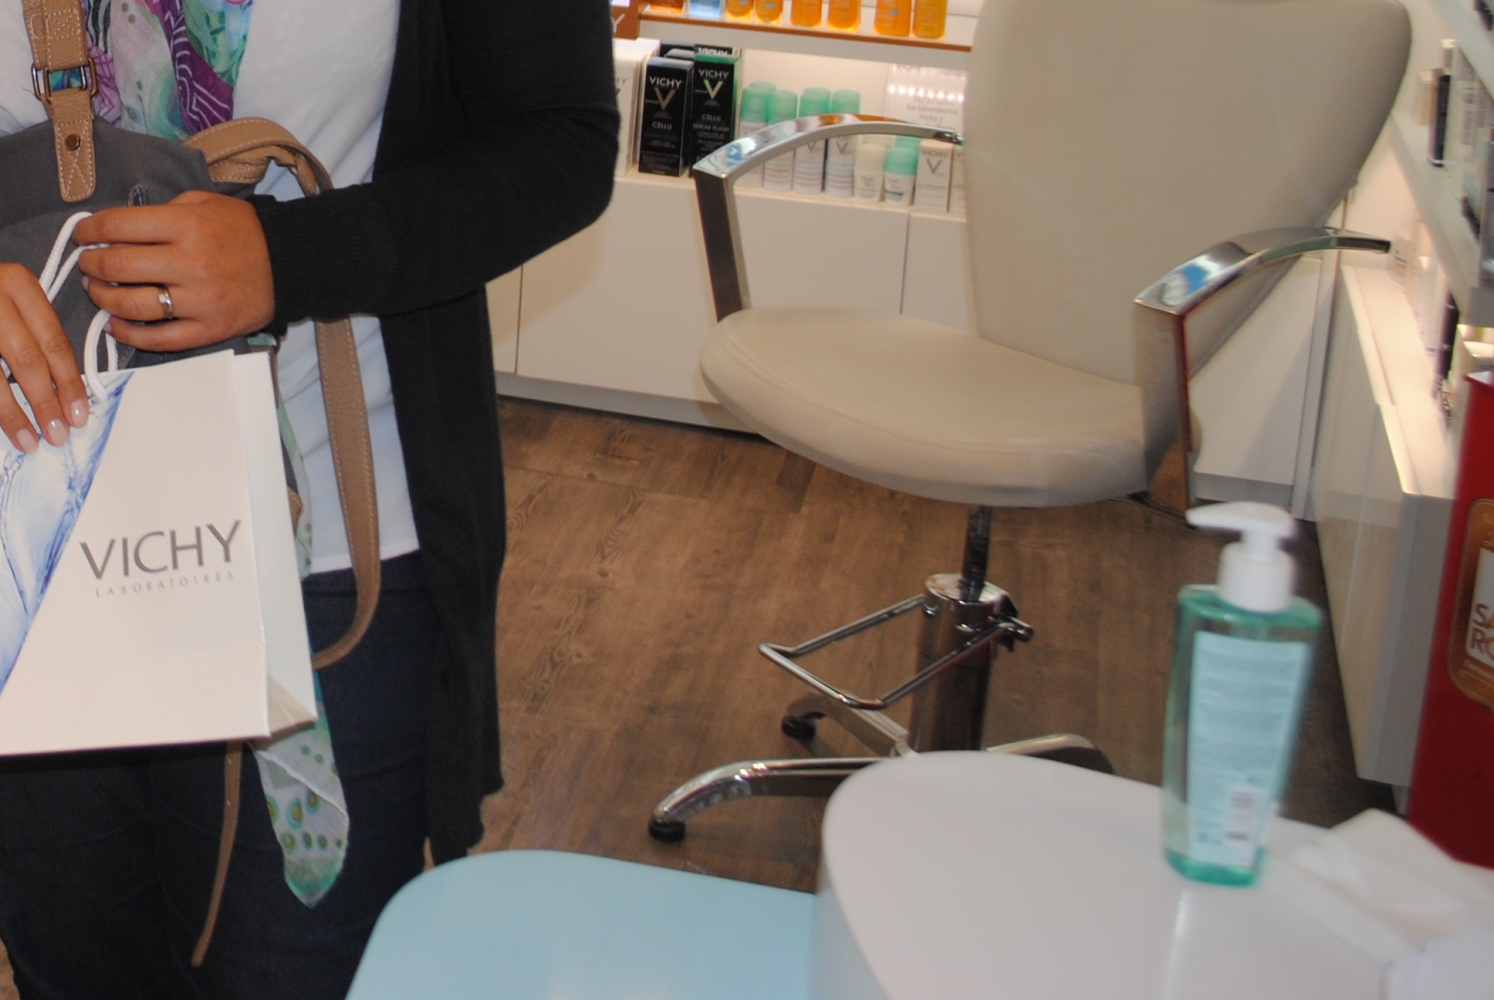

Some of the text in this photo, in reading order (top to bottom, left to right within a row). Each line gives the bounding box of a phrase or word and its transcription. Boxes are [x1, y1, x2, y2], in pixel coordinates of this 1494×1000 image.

[698, 68, 729, 79] VICHY
[649, 76, 683, 89] VICHY
[701, 113, 722, 122] CELLU
[651, 121, 673, 130] CELLU
[922, 150, 948, 158] VICHY
[79, 519, 241, 580] VICHY
[95, 572, 235, 598] LABORATOIRES
